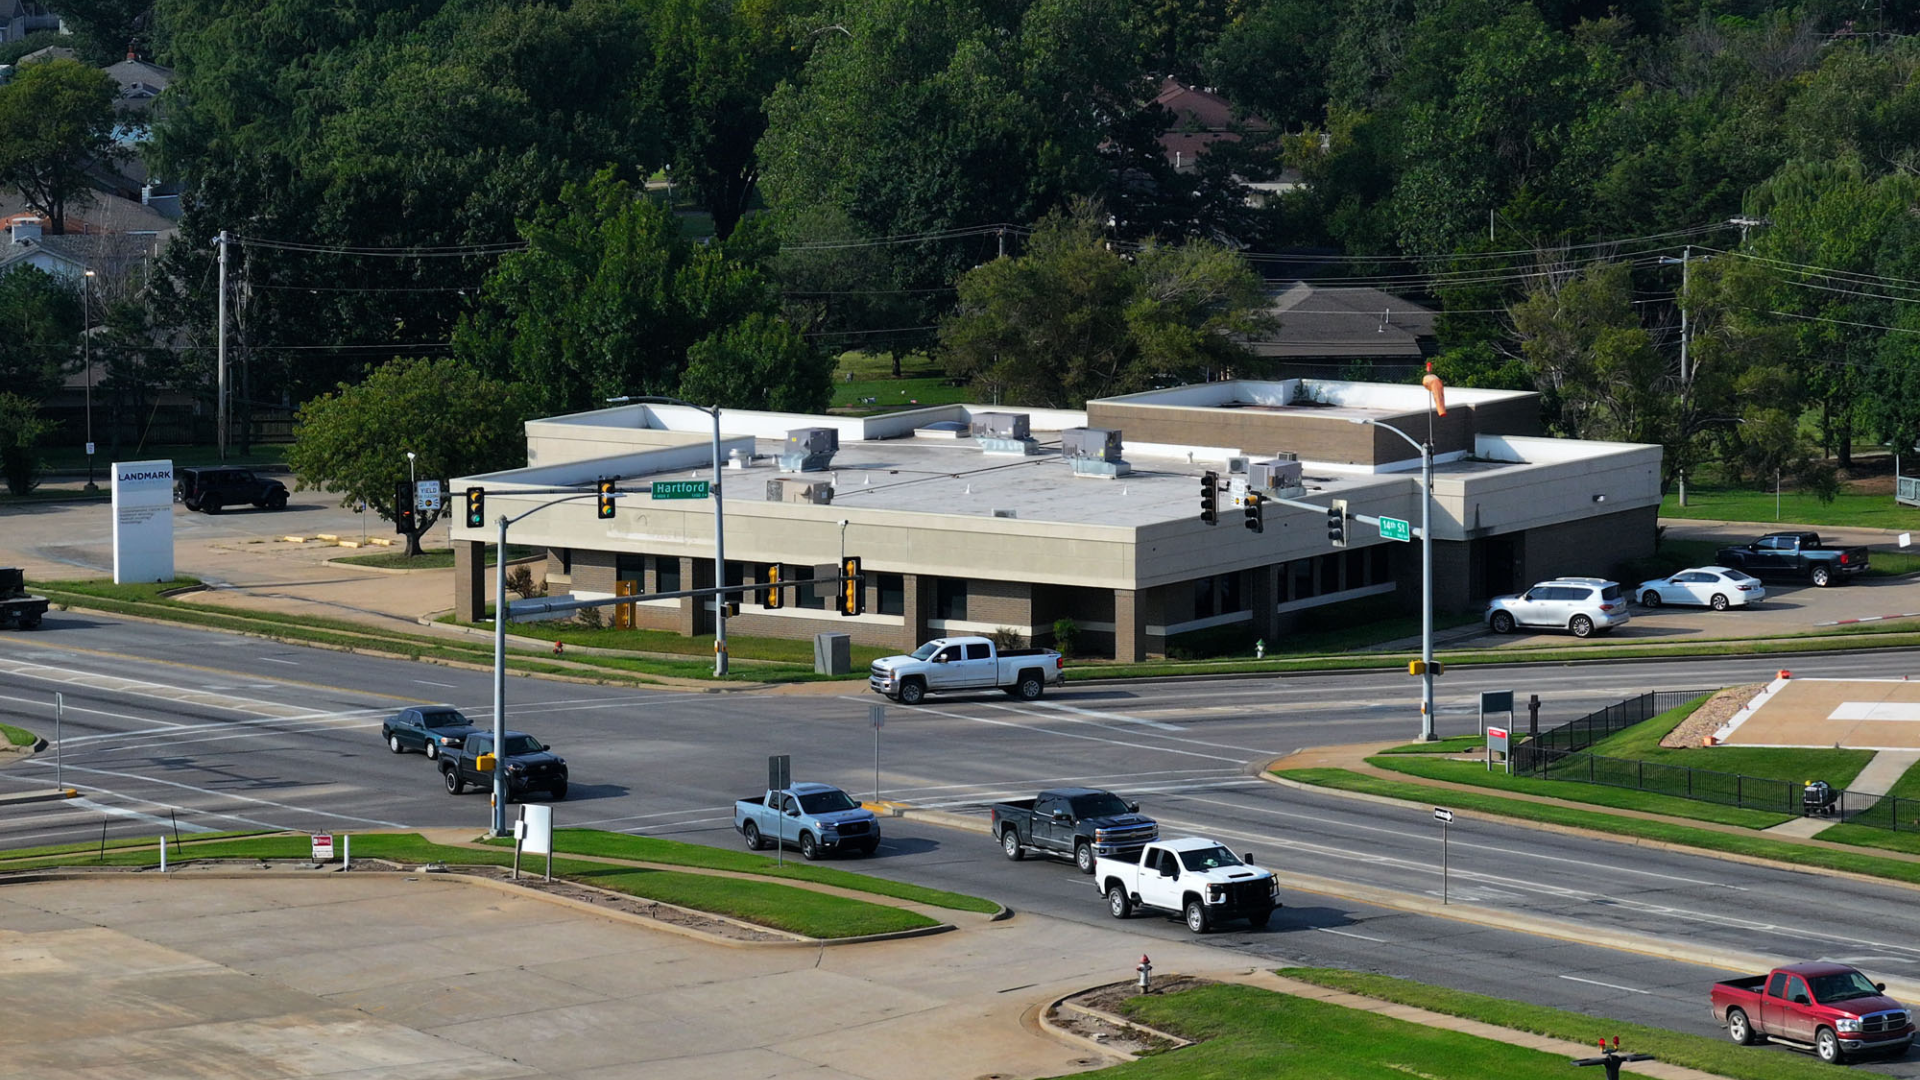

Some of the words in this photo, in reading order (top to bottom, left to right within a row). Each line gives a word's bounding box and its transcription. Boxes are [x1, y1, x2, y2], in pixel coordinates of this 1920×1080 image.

[118, 471, 171, 481] LANDMARK
[657, 482, 705, 493] Hartford
[1383, 520, 1396, 530] 14th
[1397, 522, 1405, 533] St
